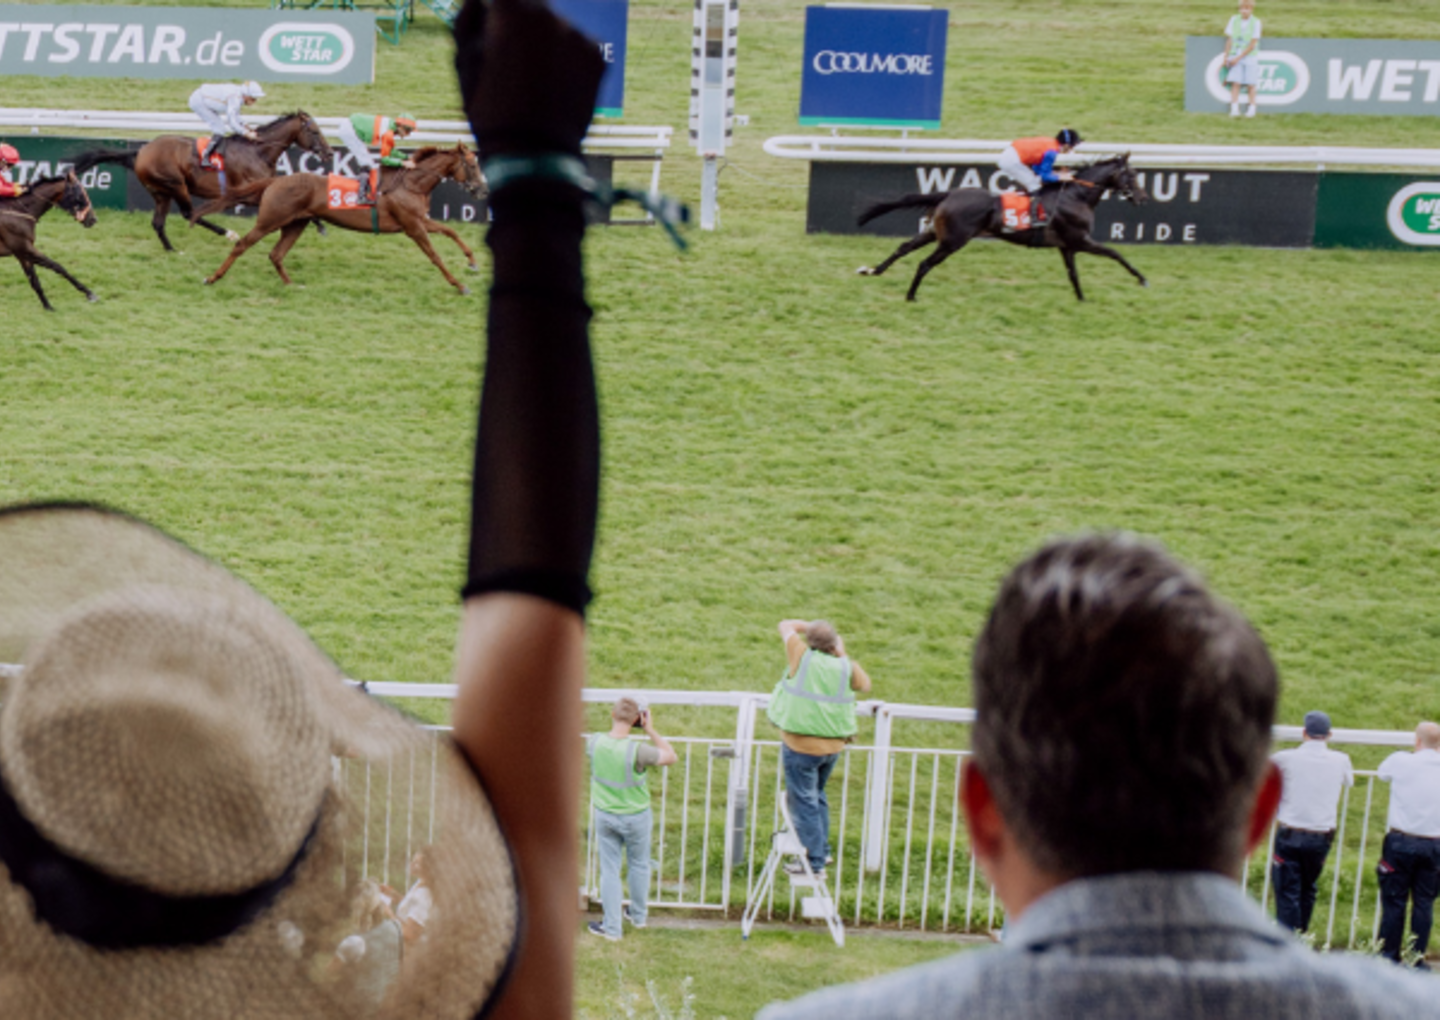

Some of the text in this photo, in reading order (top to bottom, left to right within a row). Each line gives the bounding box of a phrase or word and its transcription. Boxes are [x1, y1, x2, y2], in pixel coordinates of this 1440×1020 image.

[280, 35, 326, 49] WETT
[291, 49, 332, 61] STAR
[813, 50, 933, 75] COOLMORE
[329, 188, 342, 207] 3
[1004, 208, 1018, 227] 5
